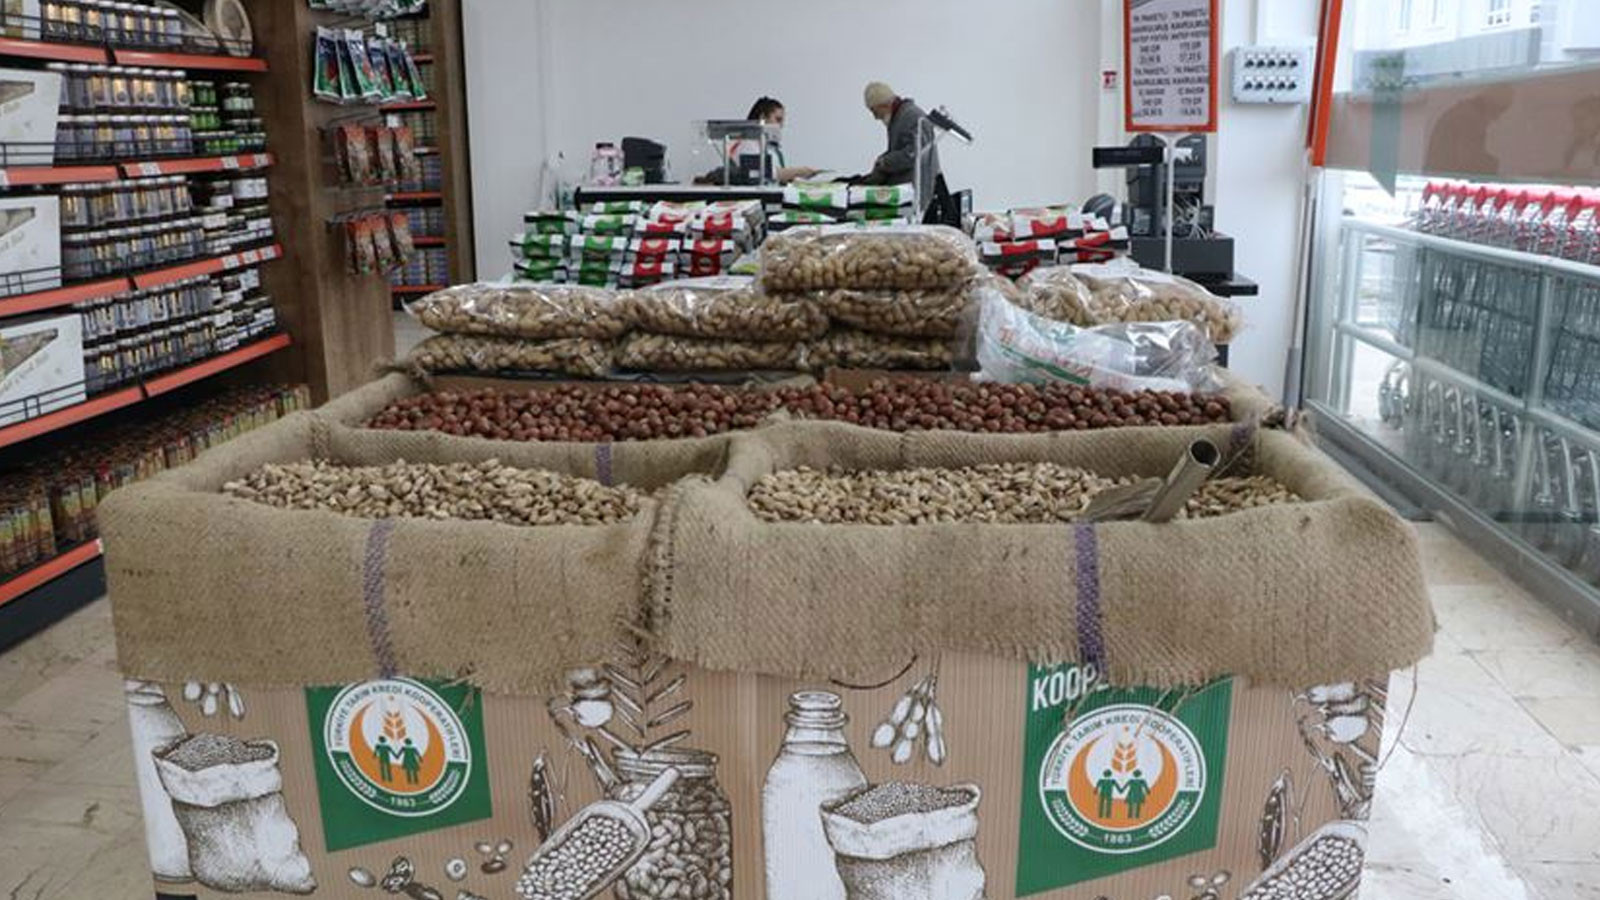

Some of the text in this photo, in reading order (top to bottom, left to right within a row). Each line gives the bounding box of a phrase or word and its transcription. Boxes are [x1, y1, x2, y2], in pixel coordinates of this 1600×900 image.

[346, 688, 370, 708] TARIM
[372, 684, 403, 694] KREDİ
[1073, 720, 1102, 741] TARIM
